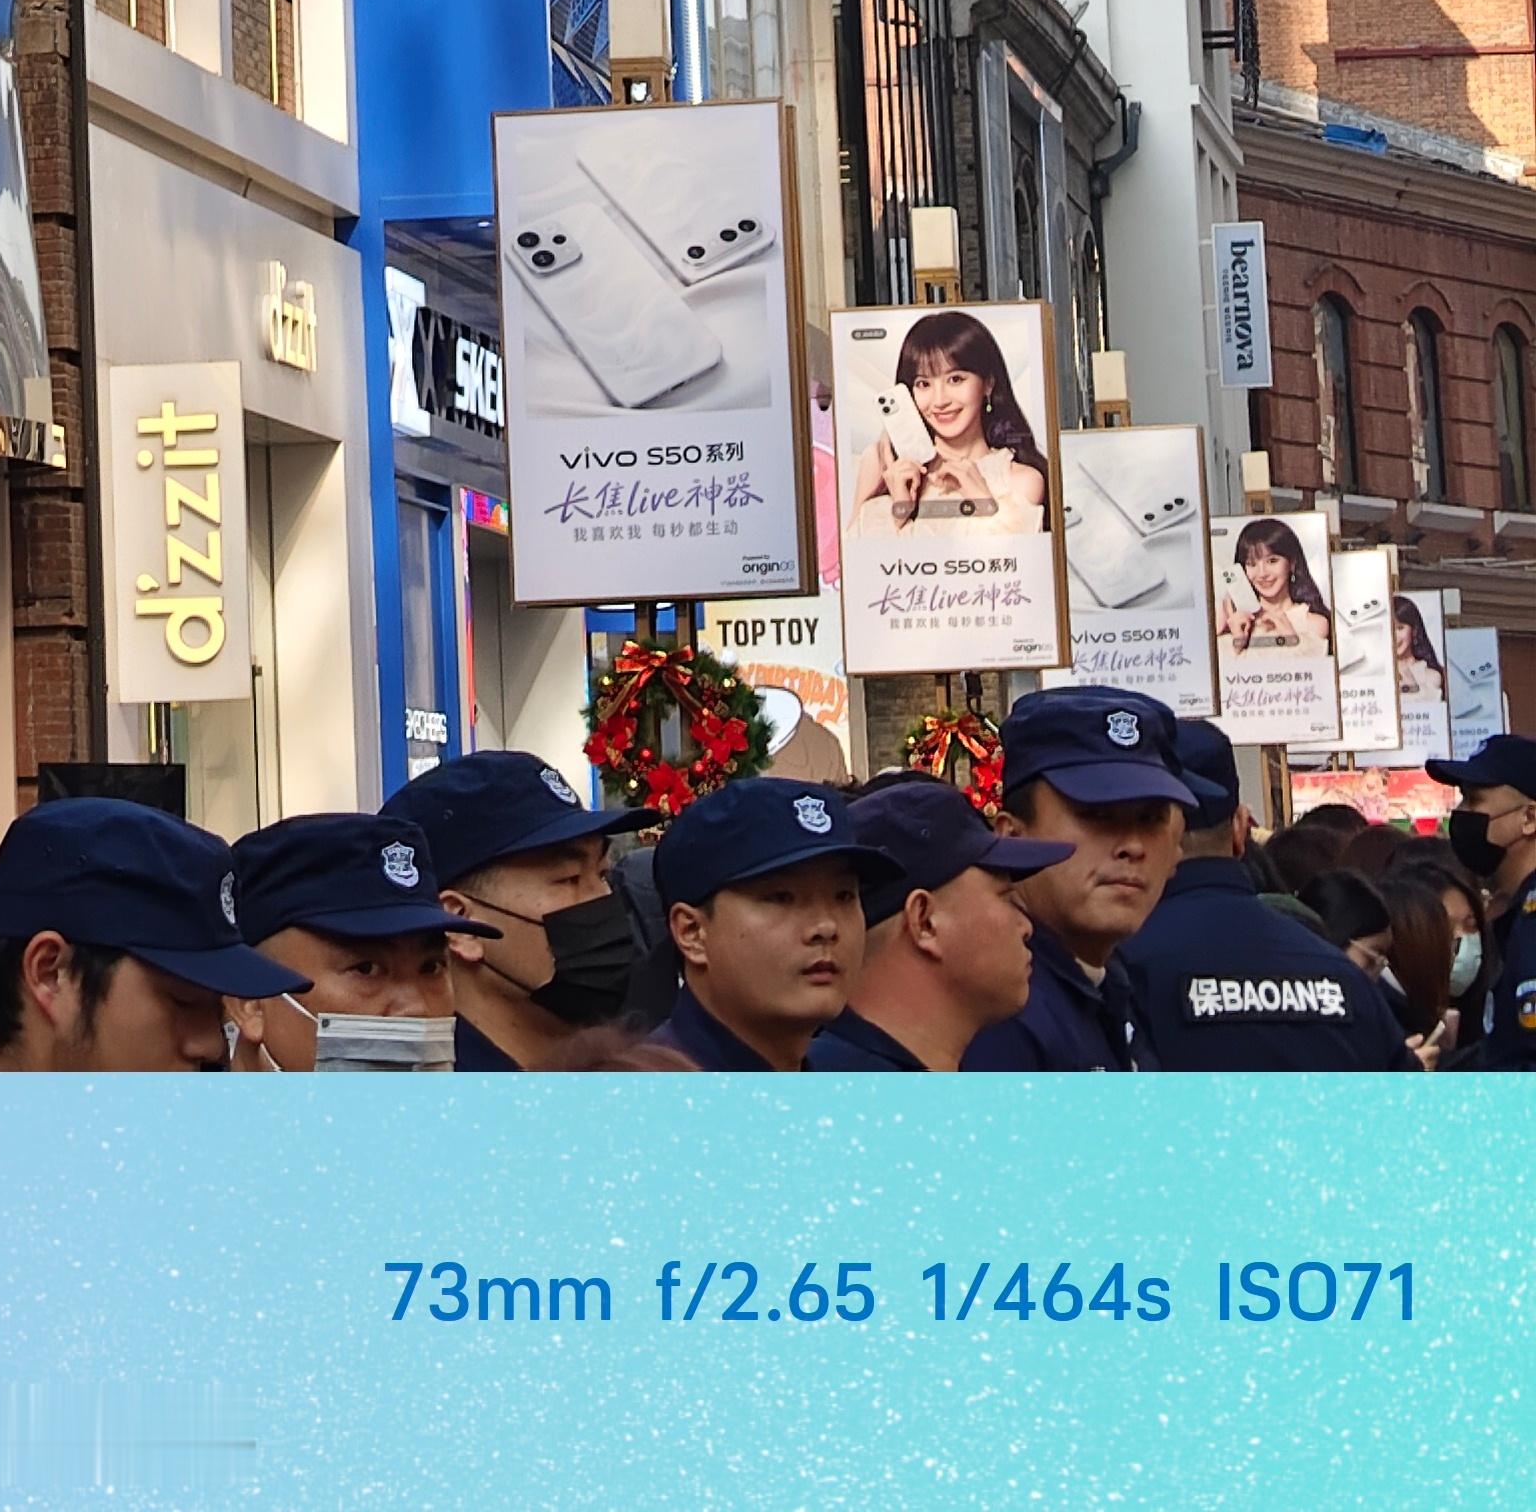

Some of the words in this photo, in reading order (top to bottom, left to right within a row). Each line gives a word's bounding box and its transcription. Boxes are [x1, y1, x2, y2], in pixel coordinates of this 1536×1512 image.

[560, 446, 638, 470] vivo
[647, 441, 744, 466] S50系列
[544, 471, 764, 524] 长焦live神器
[573, 525, 642, 543] 我喜欢我
[652, 520, 739, 538] 每秒都生动
[880, 558, 938, 576] vivo
[944, 556, 1018, 576] S50系列
[868, 579, 1032, 616] 长焦live神器
[716, 618, 765, 648] TOP
[770, 616, 819, 646] TOY
[1071, 630, 1117, 644] vivo
[1122, 627, 1180, 643] S50系列
[1226, 672, 1263, 684] vivo
[1189, 978, 1346, 1017] 保BAOAN安
